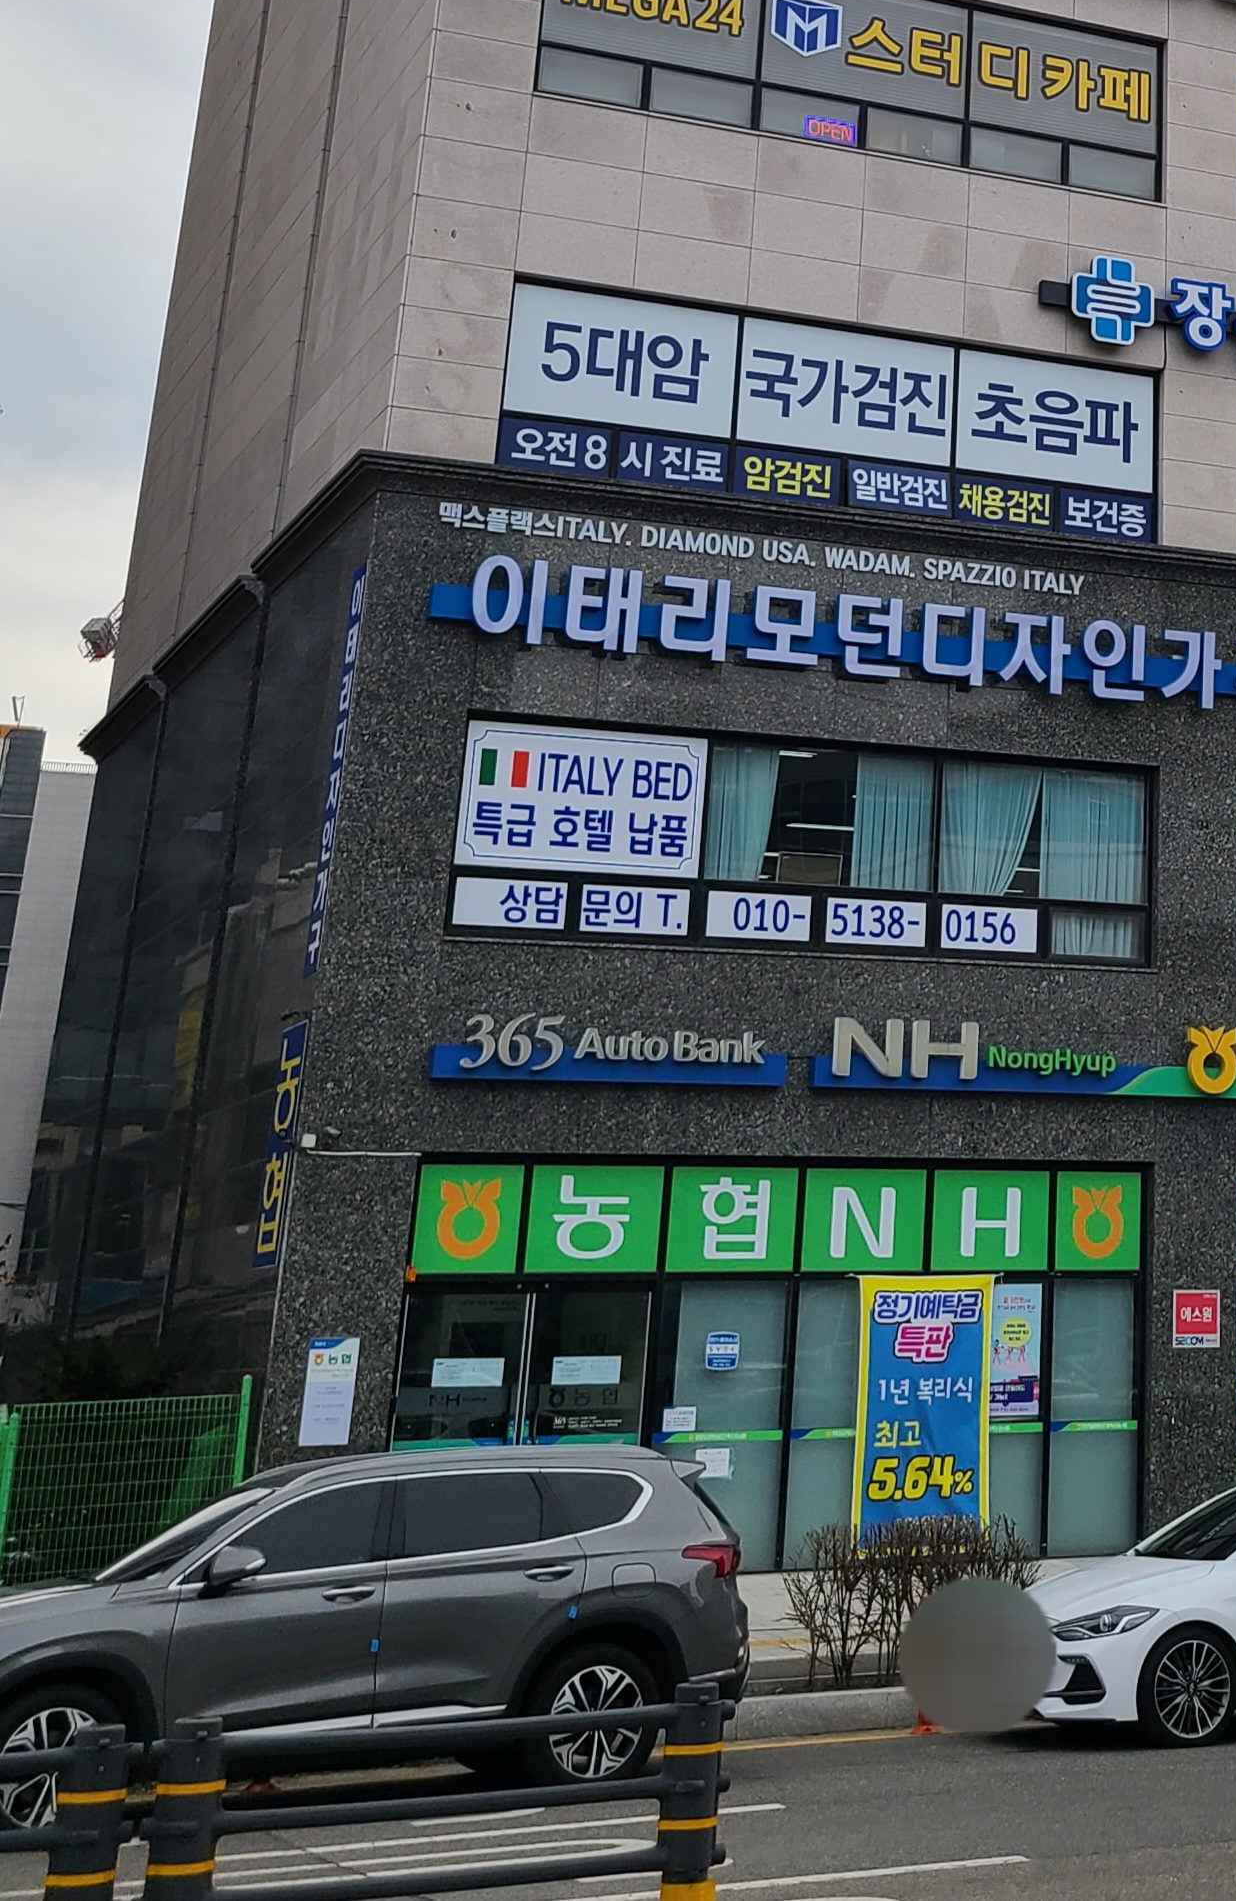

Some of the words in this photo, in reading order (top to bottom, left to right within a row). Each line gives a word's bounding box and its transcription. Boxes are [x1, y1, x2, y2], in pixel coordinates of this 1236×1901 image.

[844, 16, 1153, 123] 스터디카페
[807, 118, 854, 144] OPEN
[540, 320, 711, 405] 5대암
[744, 347, 948, 438] 국가검진
[970, 381, 1139, 464] 초음파
[510, 426, 581, 468] 오전
[660, 443, 724, 485] 진료
[742, 455, 832, 499] 암검진
[851, 467, 950, 512] 일반검진
[957, 484, 1052, 527] 채용검진
[1064, 497, 1147, 538] 보건증
[639, 526, 756, 560] DIAMOND
[762, 537, 816, 568] USA.
[824, 546, 916, 579] WADAM.
[923, 557, 1017, 589] SPAZZIO
[1022, 568, 1086, 596] ITALY
[535, 751, 625, 798] ITALY
[631, 759, 694, 802] BED
[471, 800, 538, 849] 특급
[548, 805, 614, 854] 호텔
[628, 810, 689, 859] 납품
[499, 882, 566, 925] 상담
[582, 886, 644, 930] 문의
[656, 892, 684, 931] T.
[459, 1011, 566, 1072] 365
[573, 1026, 670, 1064] Auto
[673, 1027, 768, 1066] Bank
[831, 1015, 981, 1080] NH
[987, 1043, 1119, 1076] NongHyup
[874, 1291, 982, 1323] 정기예탁금
[1179, 1306, 1213, 1324] 에스원
[895, 1324, 954, 1361] 특판
[1174, 1336, 1205, 1347] SECOM
[877, 1377, 911, 1406] 1년
[915, 1376, 974, 1406] 복리식
[872, 1420, 923, 1450] 최고
[866, 1455, 975, 1503] 5.64%
